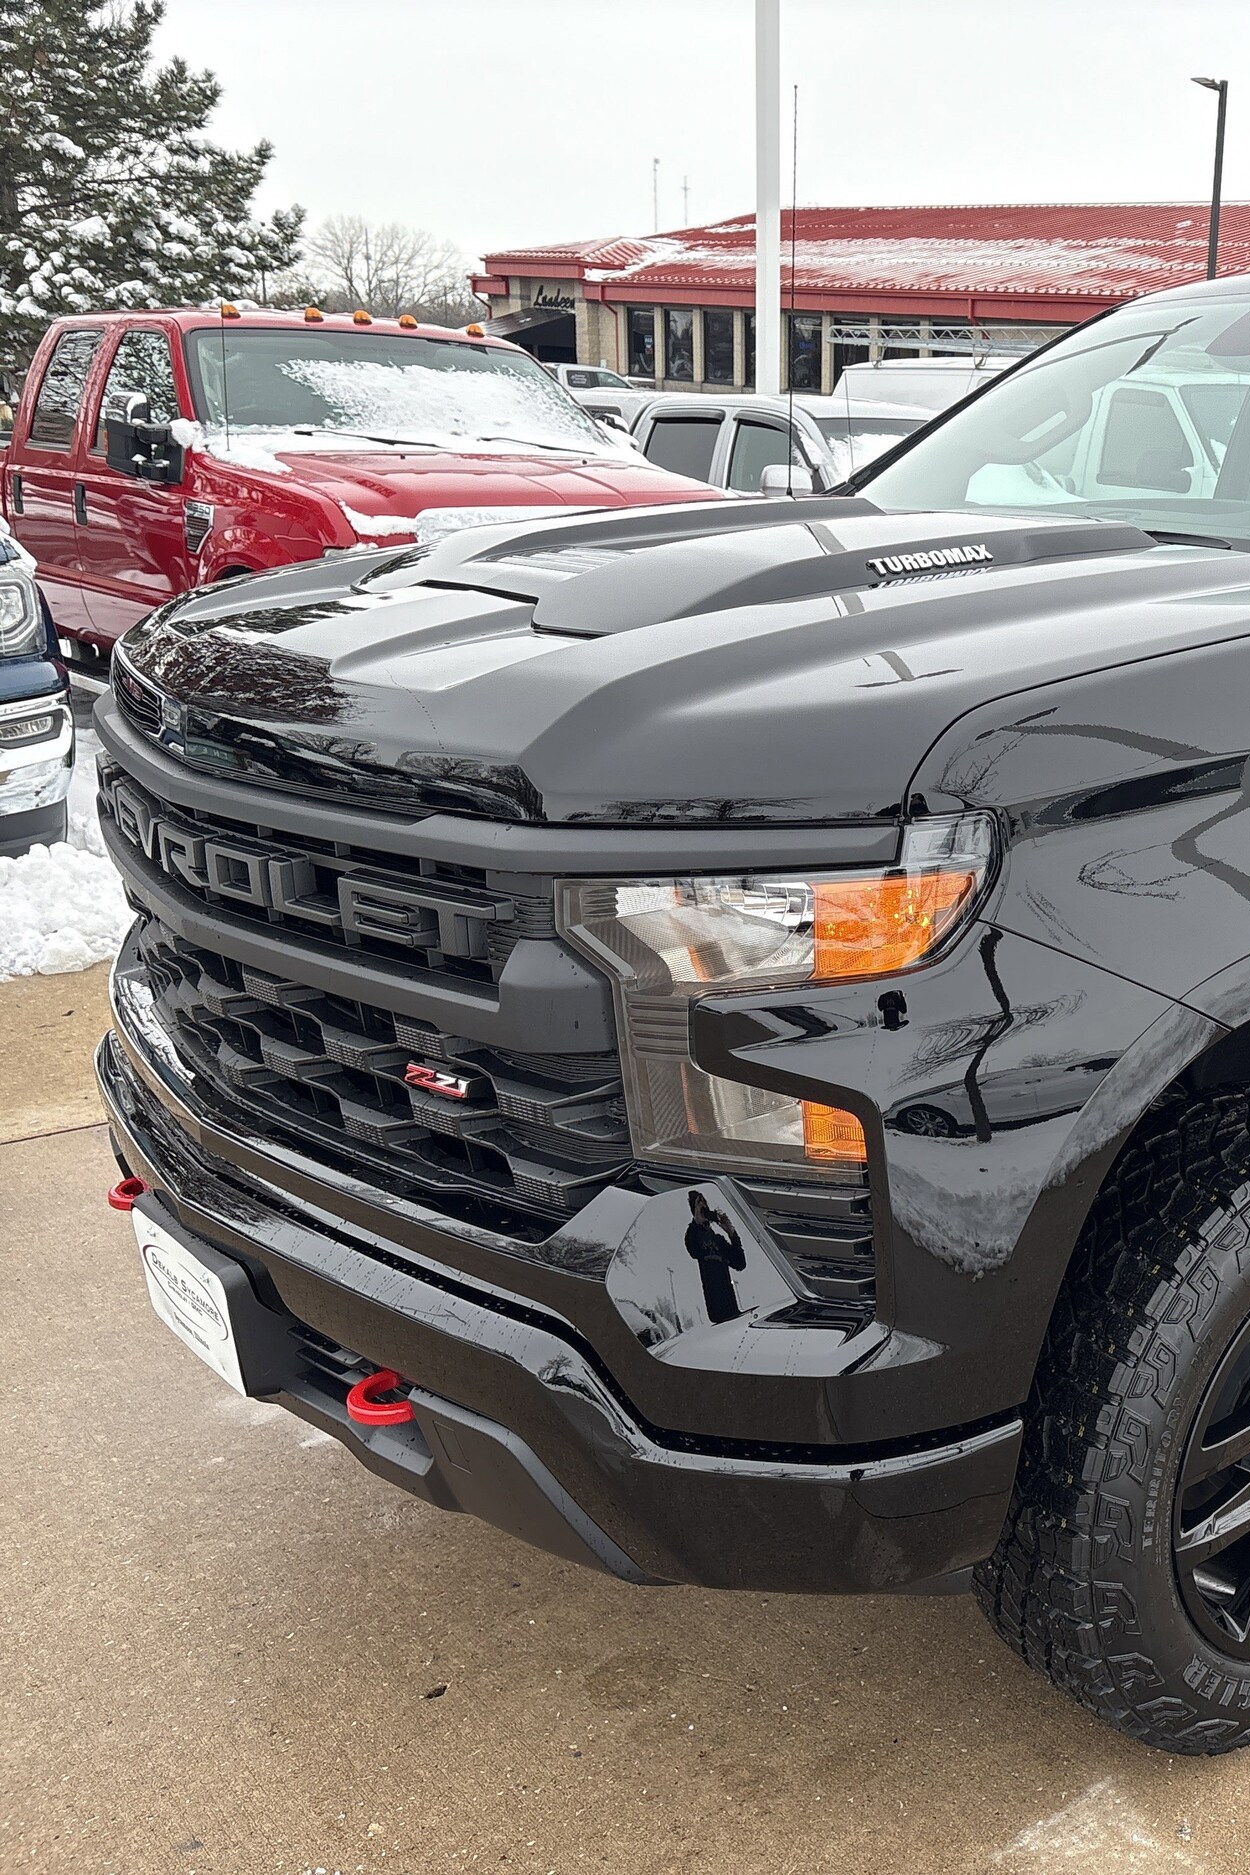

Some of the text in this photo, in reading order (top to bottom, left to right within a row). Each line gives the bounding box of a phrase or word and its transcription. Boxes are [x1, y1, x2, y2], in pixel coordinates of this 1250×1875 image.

[865, 544, 993, 577] TURBOMAX
[98, 764, 514, 958] HEVROLET
[404, 1063, 469, 1098] Z71
[180, 1279, 220, 1322] SYCAMORE
